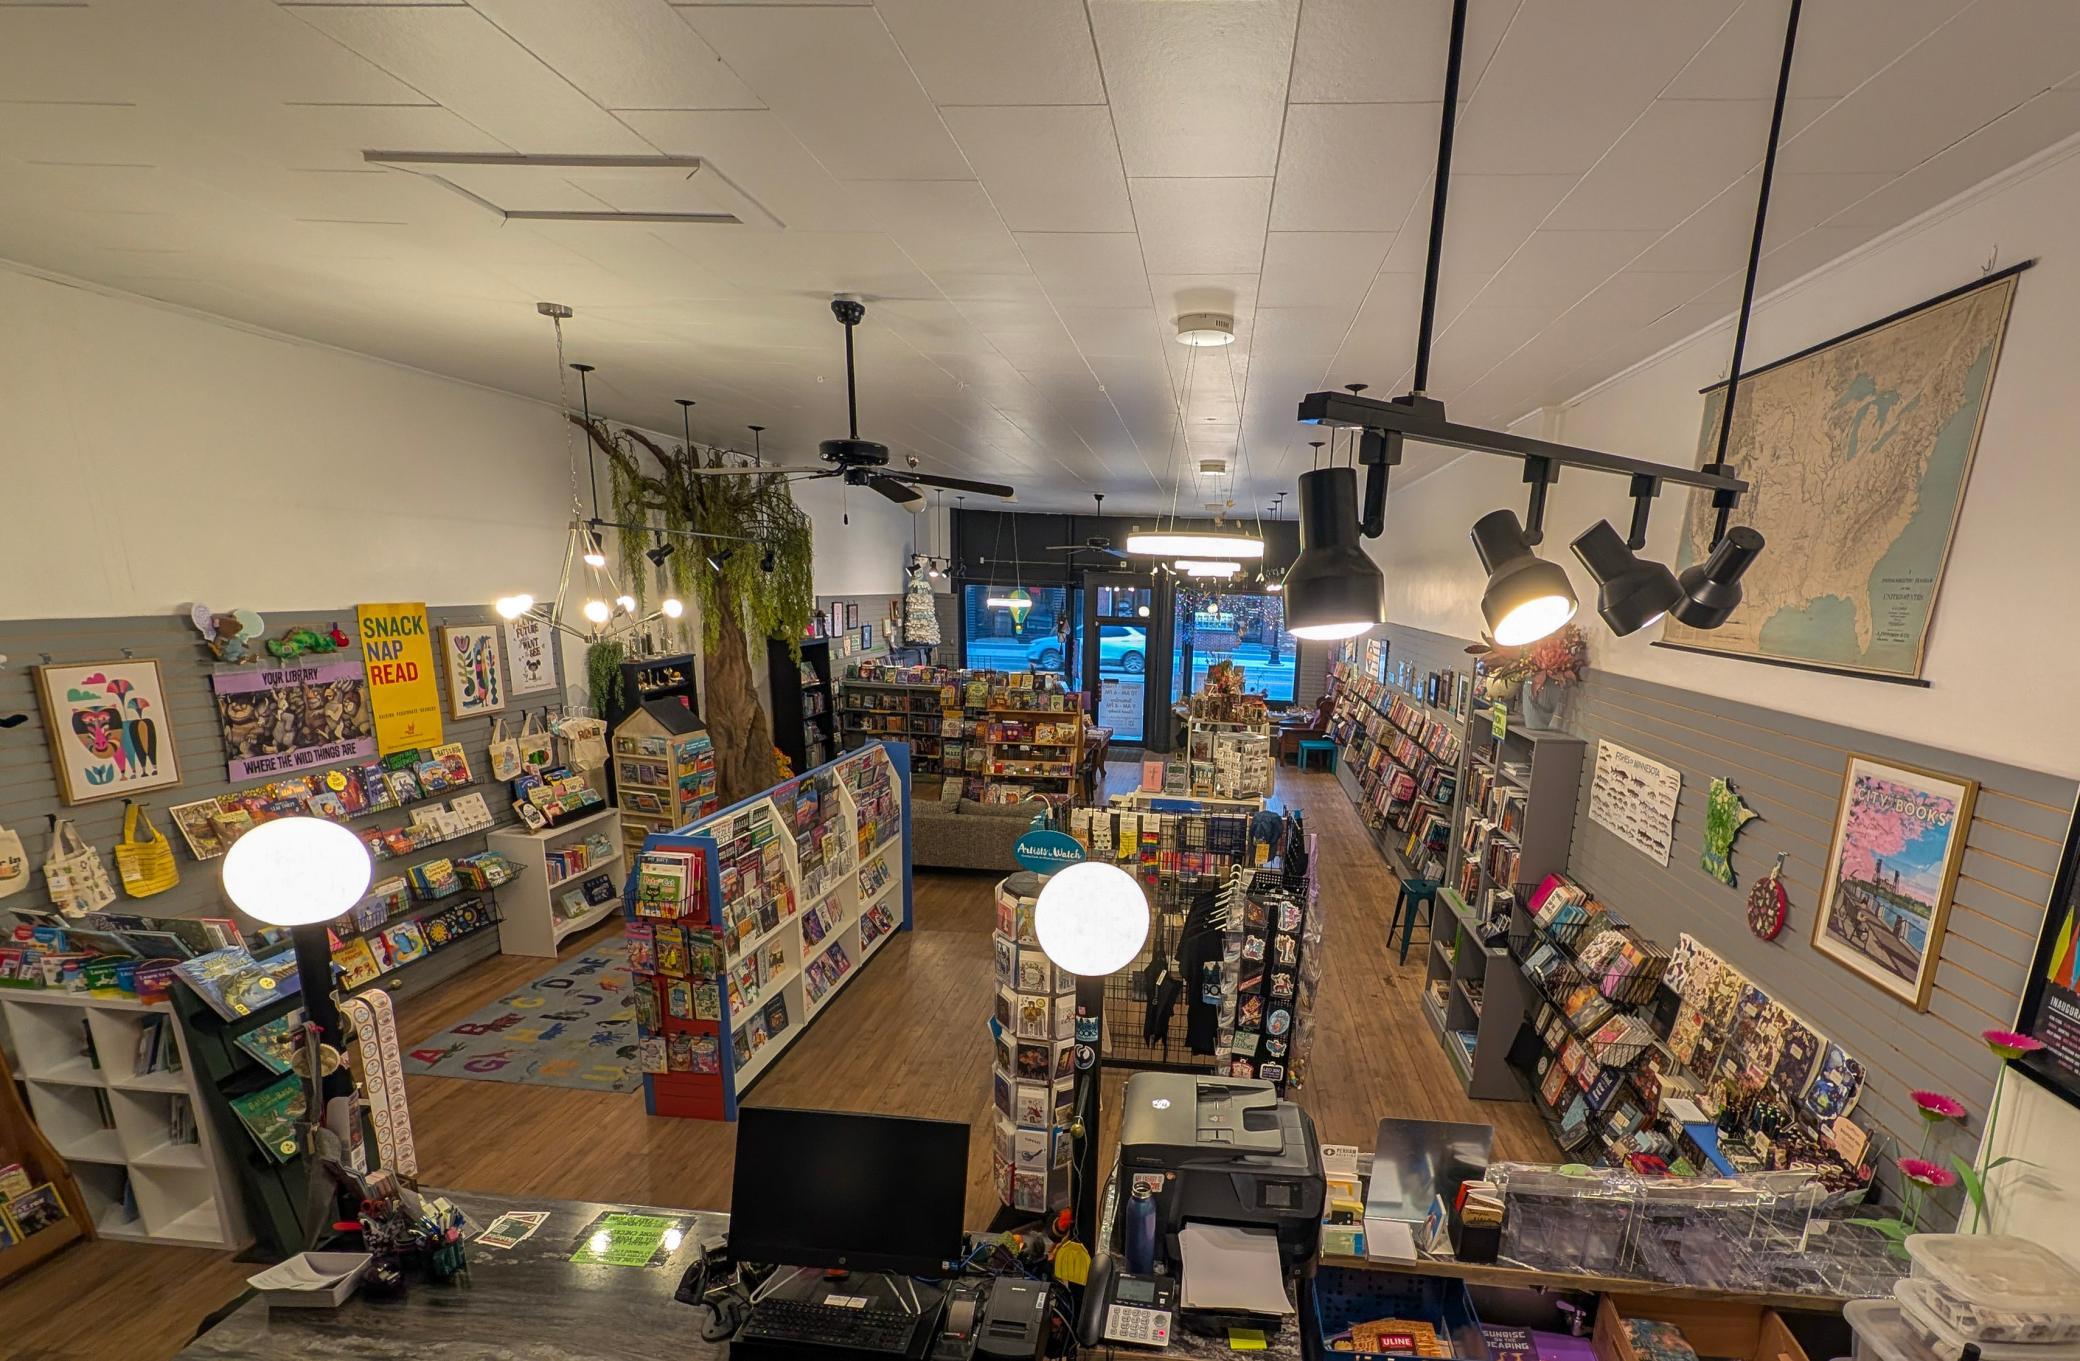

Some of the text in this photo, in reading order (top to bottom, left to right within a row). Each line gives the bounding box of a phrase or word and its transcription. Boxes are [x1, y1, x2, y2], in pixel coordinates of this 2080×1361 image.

[362, 615, 425, 639] SNACK
[515, 622, 540, 638] FUTURE
[366, 640, 404, 662] NAP
[261, 667, 319, 687] YOUR LIBRARY
[370, 661, 419, 686] READ
[243, 742, 357, 775] WHERE THE WILD THINGS ARE
[1858, 788, 1947, 827] CITY BOOKS
[1052, 846, 1082, 859] Watch
[1382, 1337, 1412, 1347] ULINE
[1483, 1331, 1526, 1339] SUNRISE
